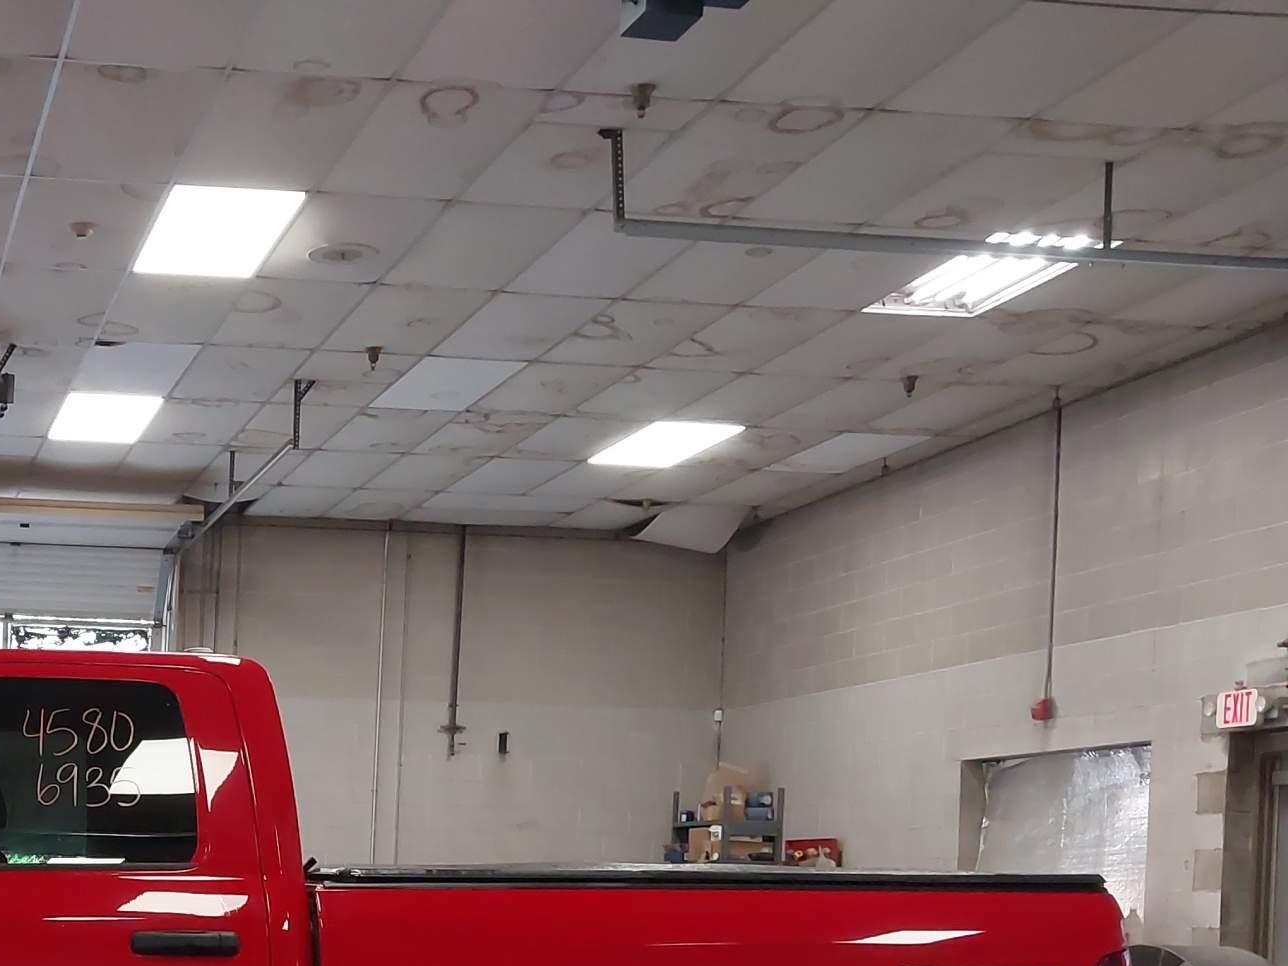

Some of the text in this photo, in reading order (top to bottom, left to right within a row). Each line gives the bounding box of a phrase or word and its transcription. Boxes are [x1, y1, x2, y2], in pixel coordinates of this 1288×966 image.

[1223, 691, 1253, 724] EXIT
[22, 707, 134, 756] 4580
[37, 762, 141, 807] 6935
